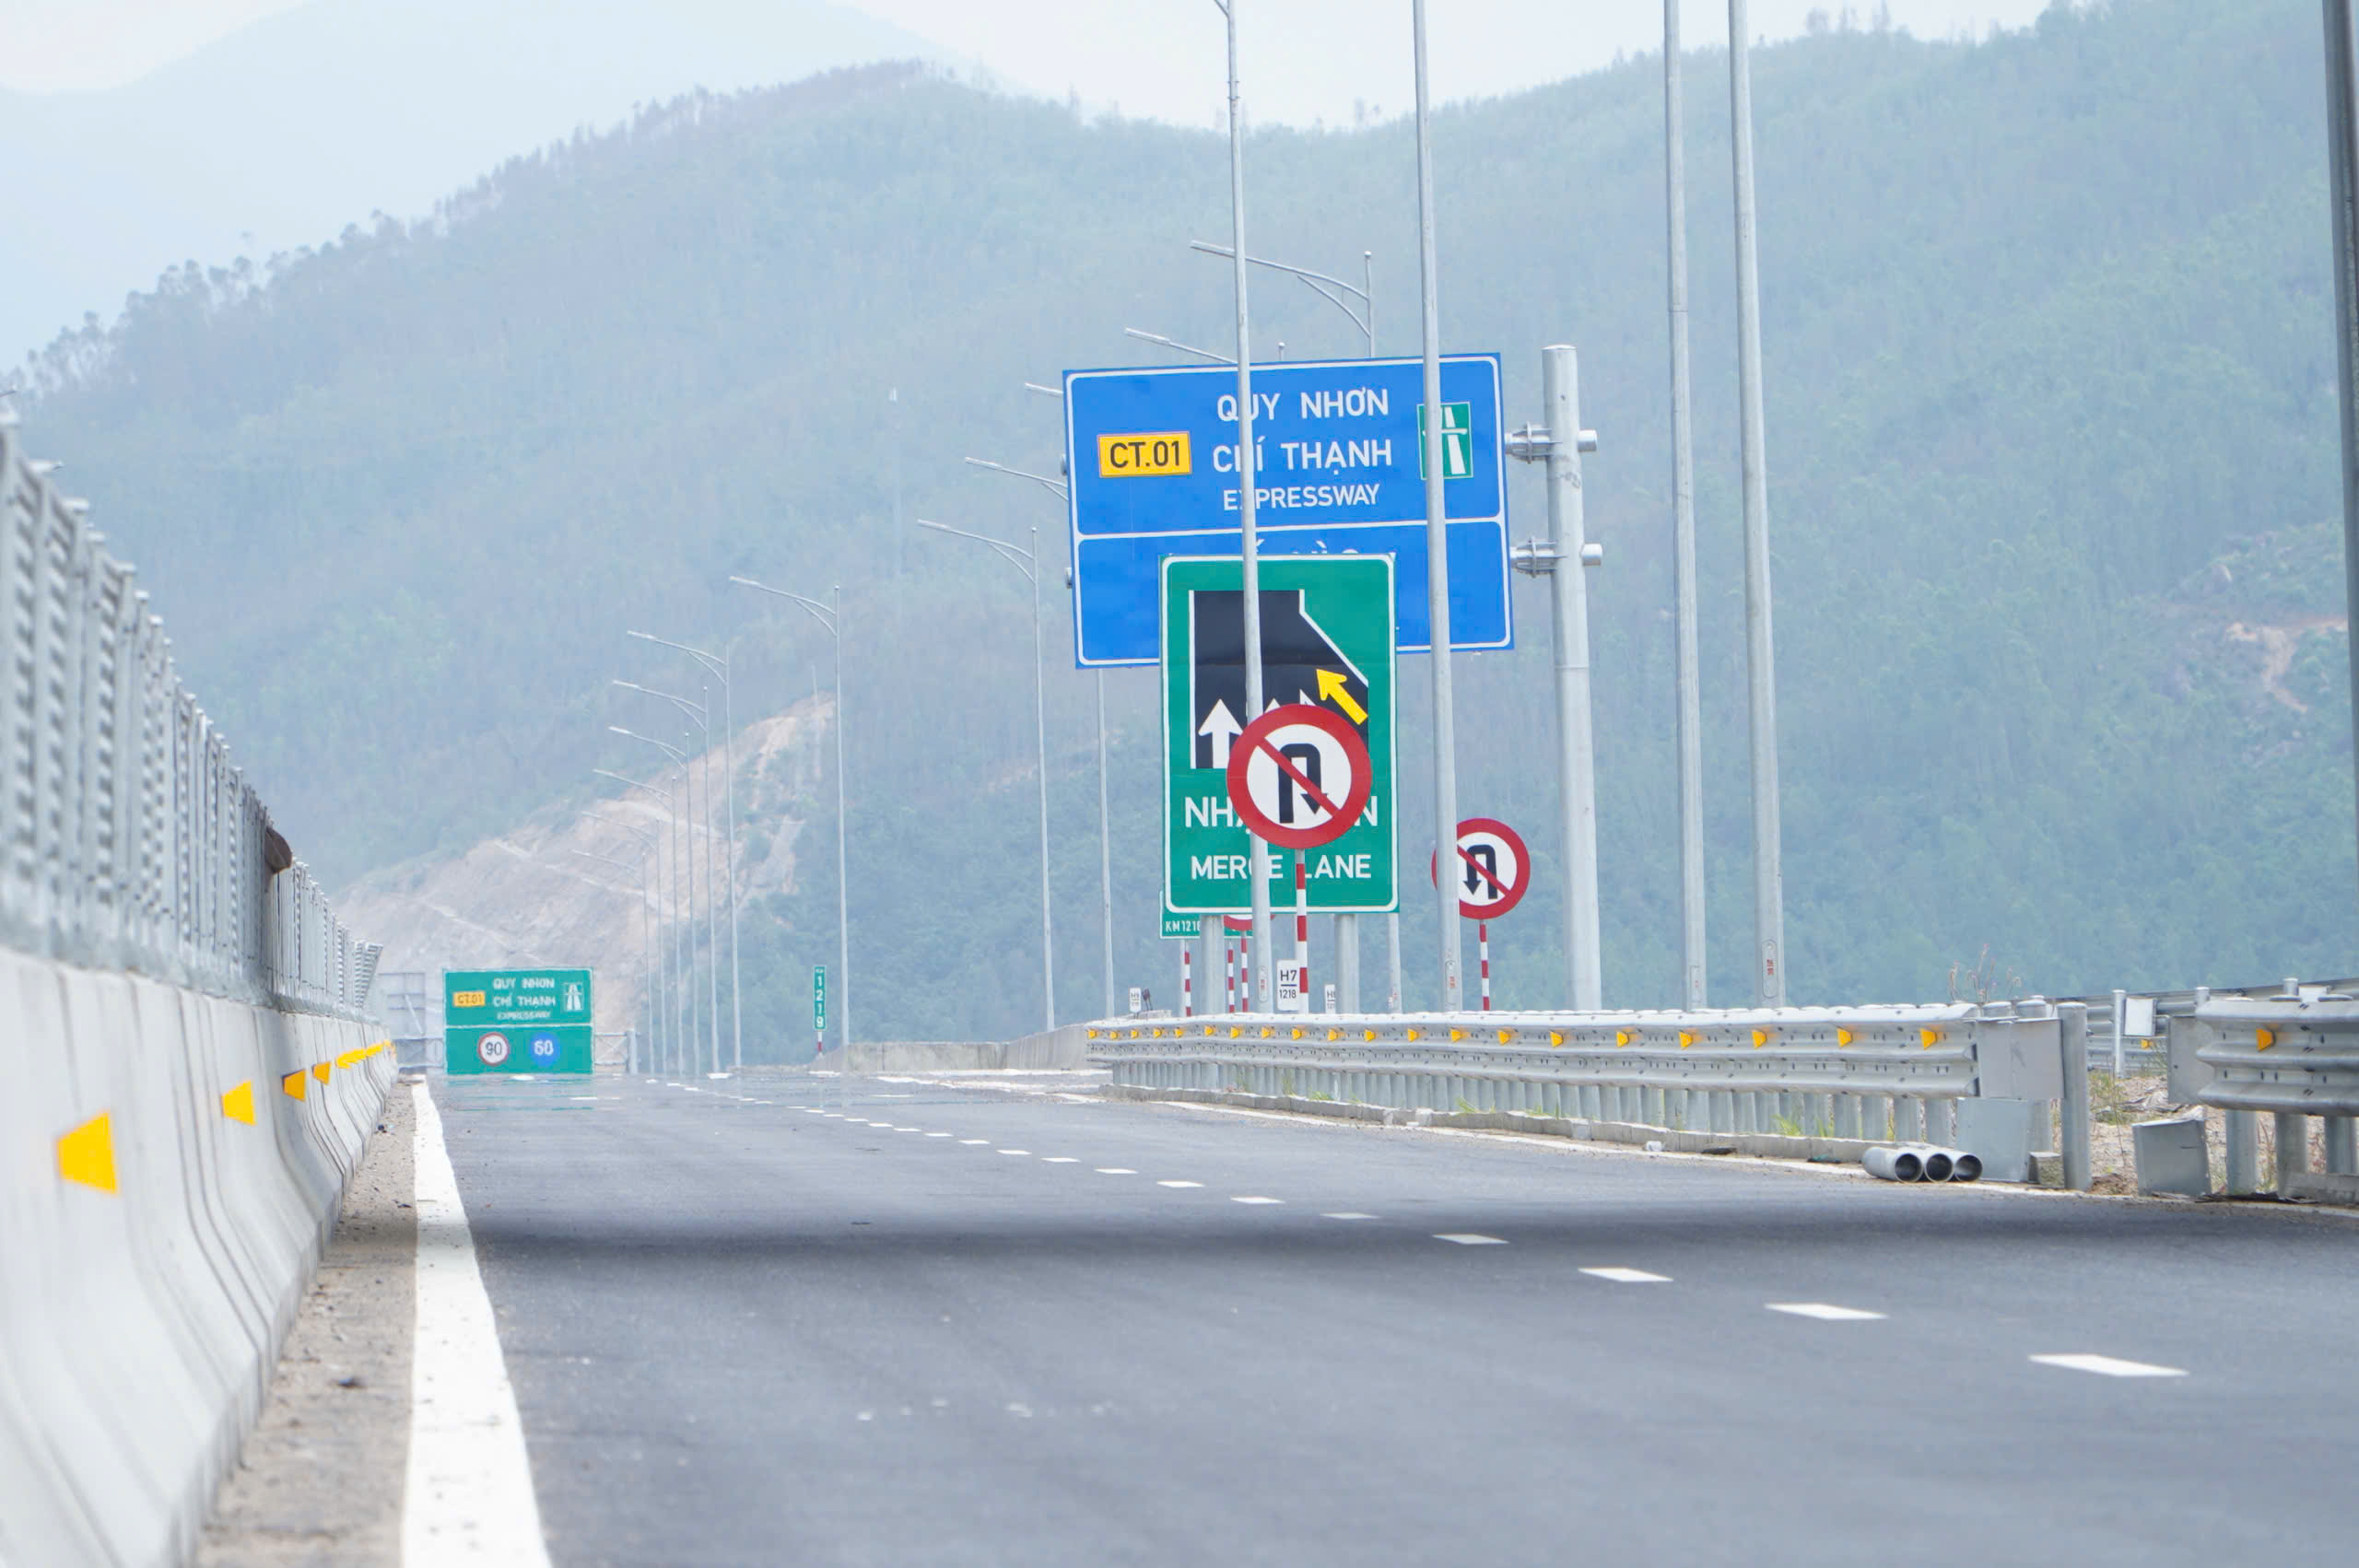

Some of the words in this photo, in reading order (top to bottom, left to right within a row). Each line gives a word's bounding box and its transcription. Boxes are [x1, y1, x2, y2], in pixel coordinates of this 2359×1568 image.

[1300, 387, 1389, 419] NHƠN
[1109, 440, 1180, 468] CT.01
[1280, 439, 1392, 474] THẠNH
[1224, 484, 1379, 510] EPRESSWAY
[1191, 854, 1284, 879] MERE
[1280, 969, 1297, 982] H7
[1279, 989, 1297, 1000] 1218
[486, 1041, 502, 1057] 90
[534, 1039, 554, 1056] 60
